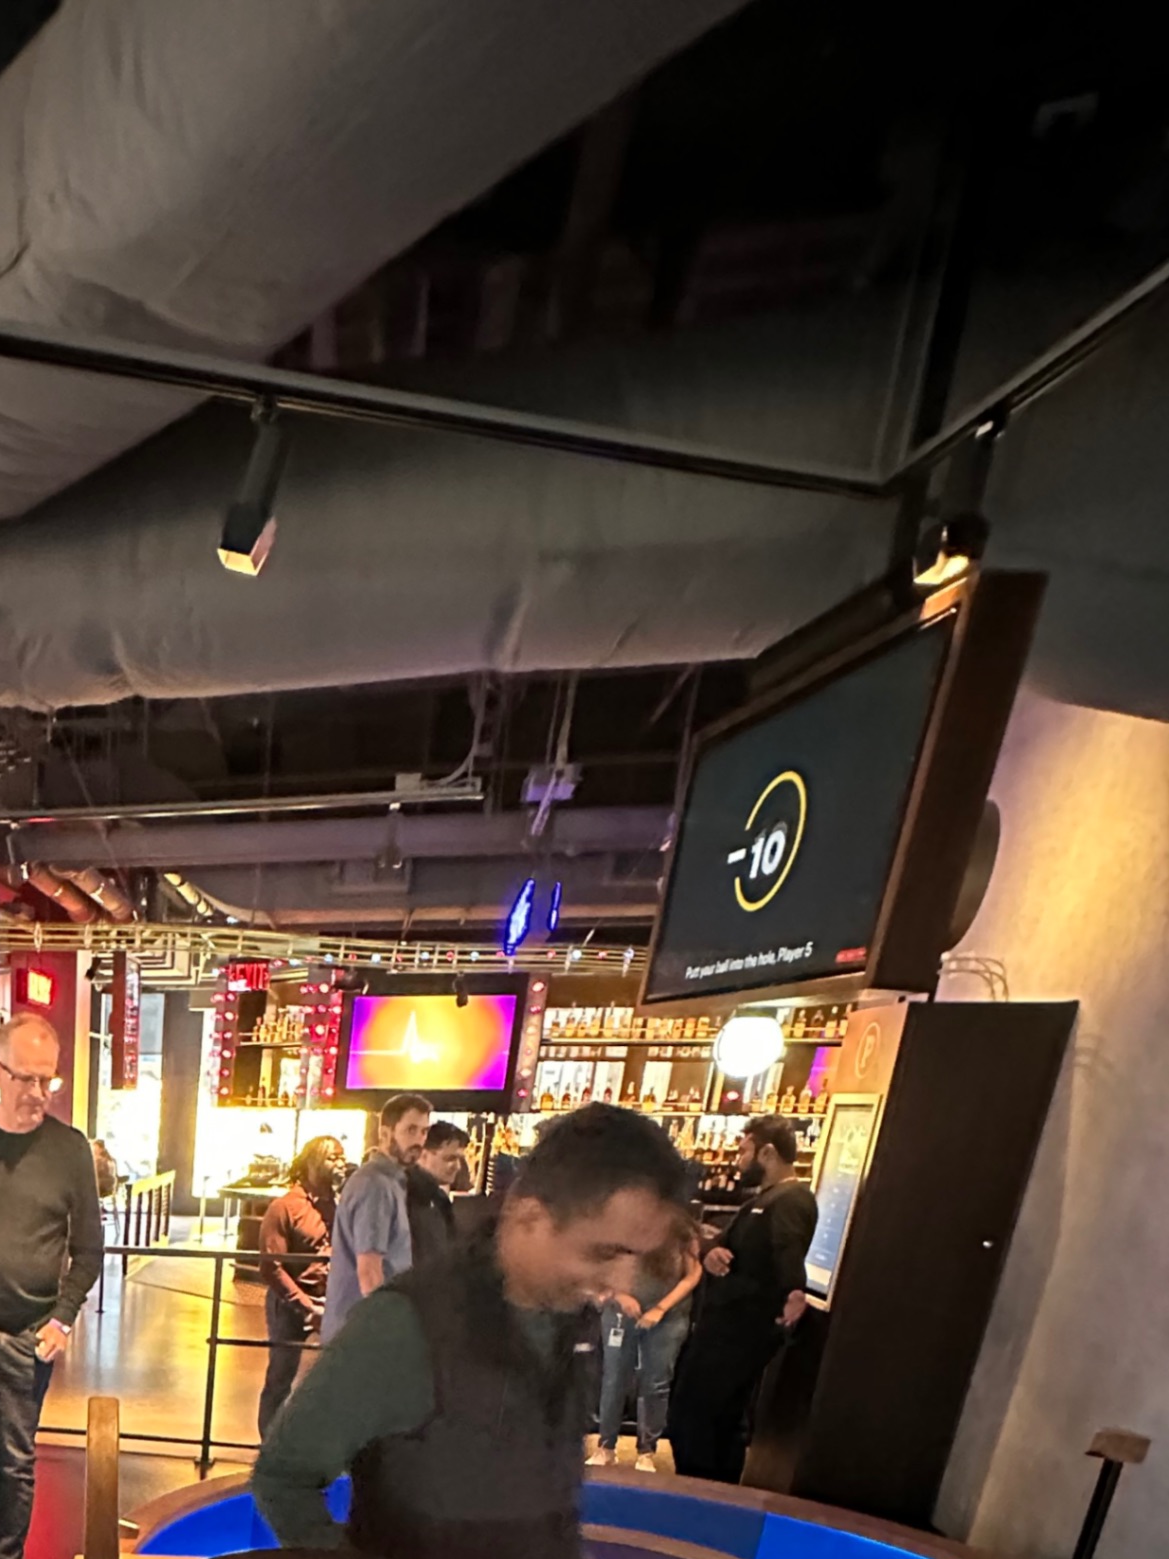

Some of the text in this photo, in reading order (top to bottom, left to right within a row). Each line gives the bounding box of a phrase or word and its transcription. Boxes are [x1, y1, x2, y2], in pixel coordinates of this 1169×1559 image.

[727, 827, 786, 879] -10
[777, 946, 805, 963] Player
[804, 941, 813, 958] 5
